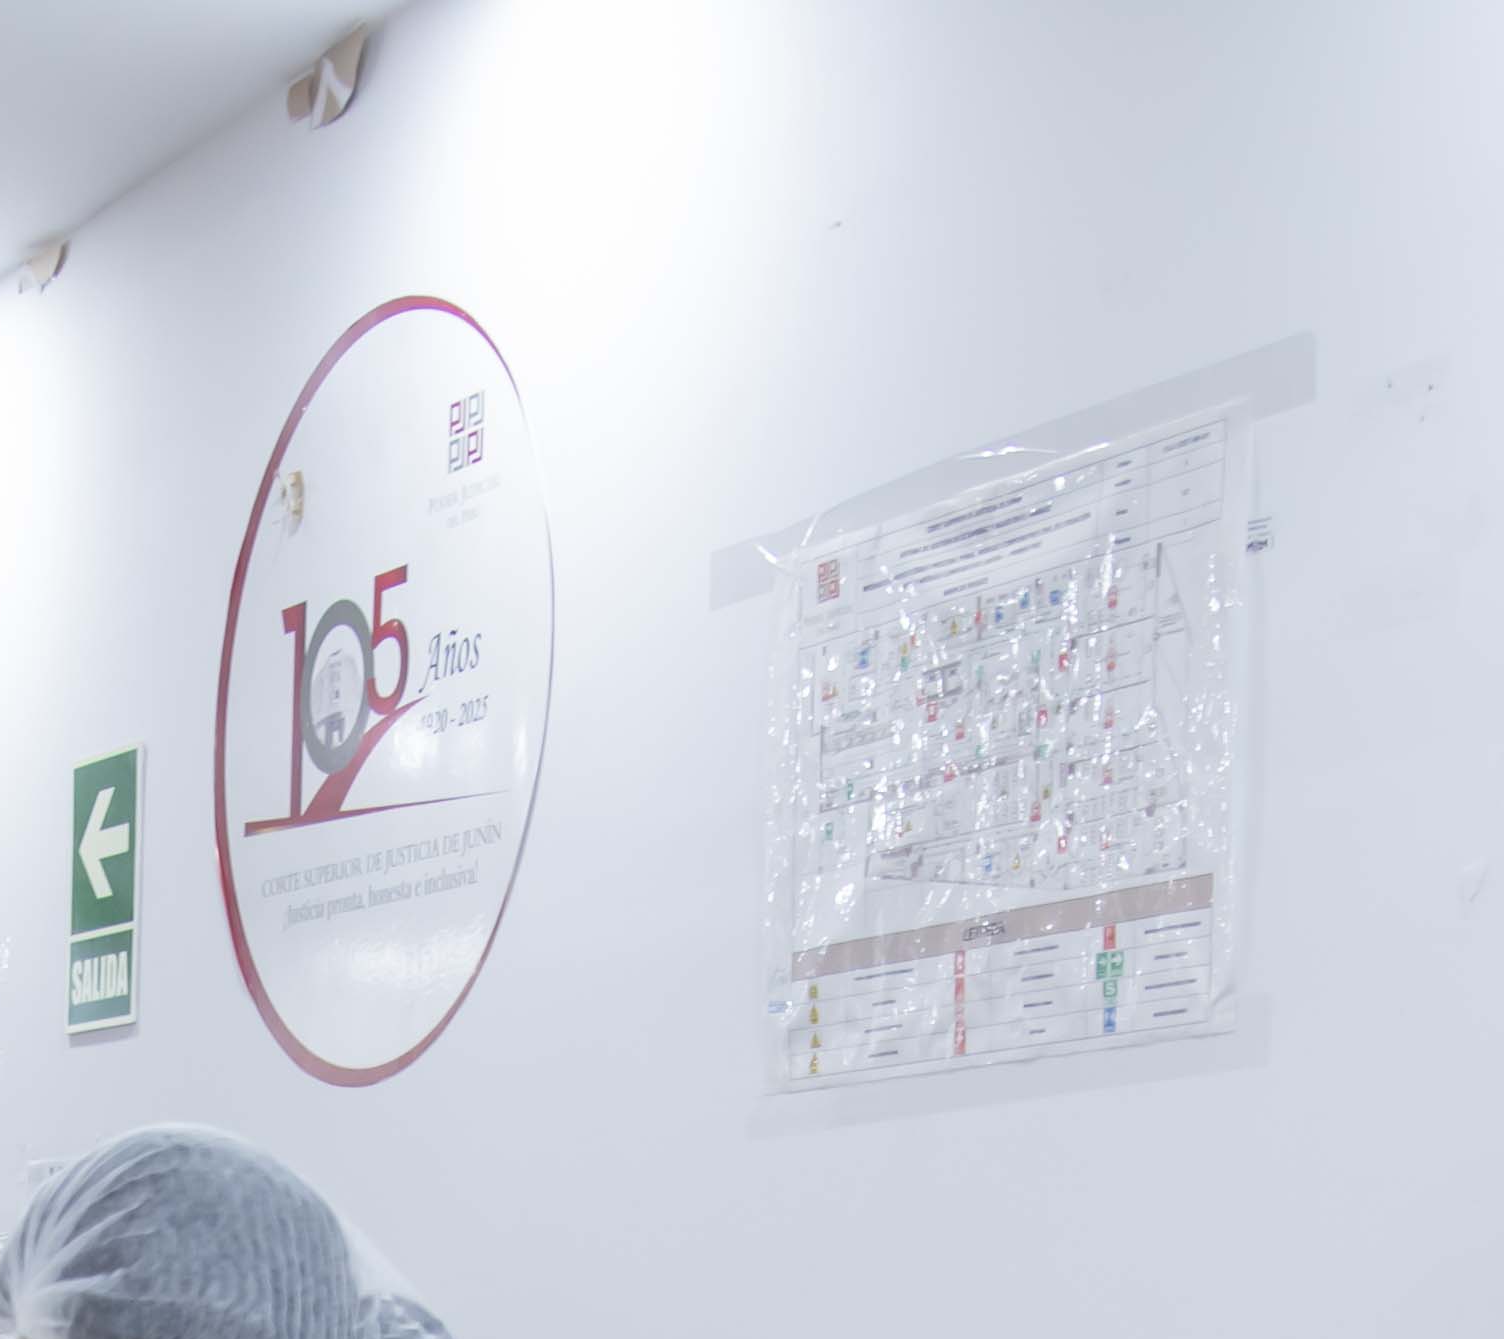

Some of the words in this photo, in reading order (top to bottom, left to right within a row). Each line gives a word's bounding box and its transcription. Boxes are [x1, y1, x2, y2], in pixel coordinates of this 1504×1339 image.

[282, 564, 409, 816] 105
[418, 629, 482, 694] Años
[458, 695, 489, 727] 2025
[261, 875, 304, 899] CORTE
[304, 857, 363, 889] SUPERIOR
[366, 851, 383, 874] DE
[383, 839, 440, 874] JUSTICIA
[442, 832, 460, 856] DE
[461, 818, 503, 857] JUNÍN
[71, 950, 129, 1006] SALIDA
